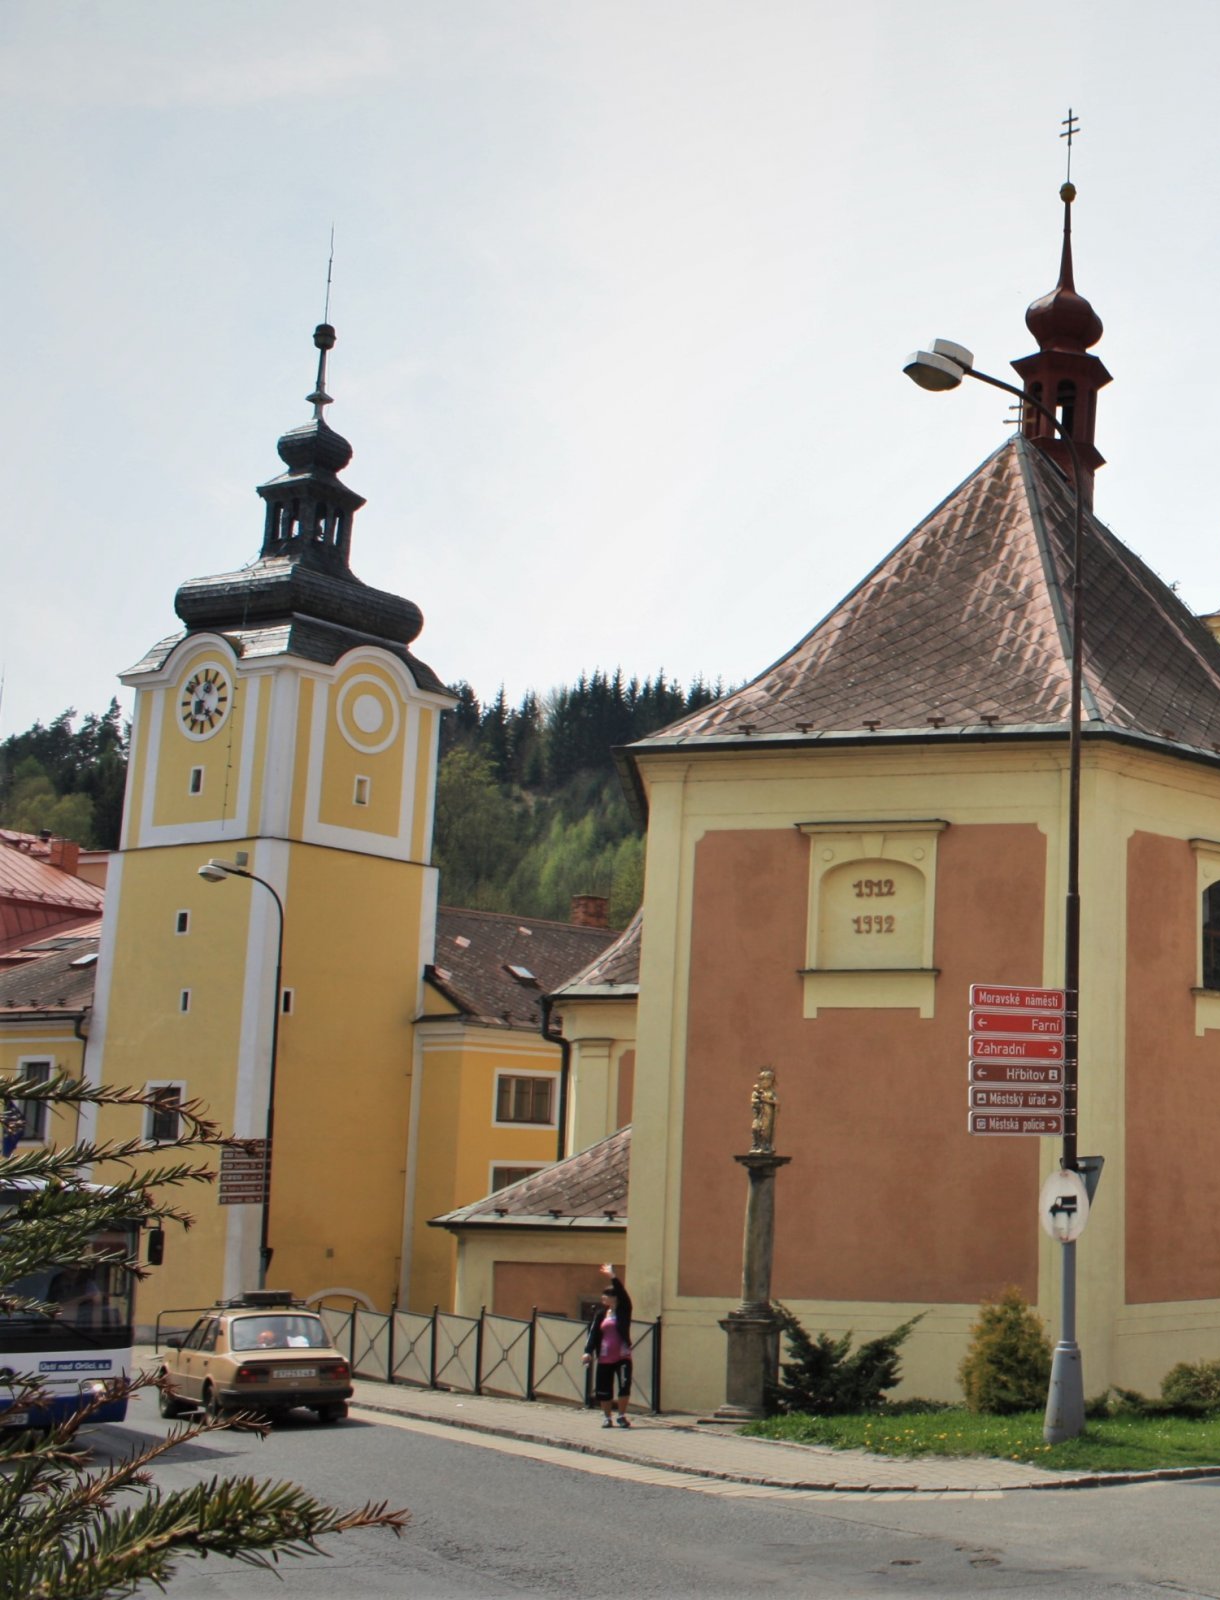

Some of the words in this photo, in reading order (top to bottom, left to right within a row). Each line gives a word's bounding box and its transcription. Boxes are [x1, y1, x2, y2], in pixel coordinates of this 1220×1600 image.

[852, 879, 896, 898] 1912
[852, 915, 895, 934] 1992
[979, 991, 1020, 1005] Moravské
[1025, 994, 1058, 1007] náměstí
[1031, 1018, 1060, 1031] Farní
[977, 1042, 1026, 1055] Zahradní
[1006, 1068, 1045, 1080] Hřbitov
[989, 1092, 1024, 1108] Městský
[1028, 1093, 1047, 1105] úřad
[989, 1117, 1019, 1130] Městská
[1022, 1118, 1046, 1133] policie
